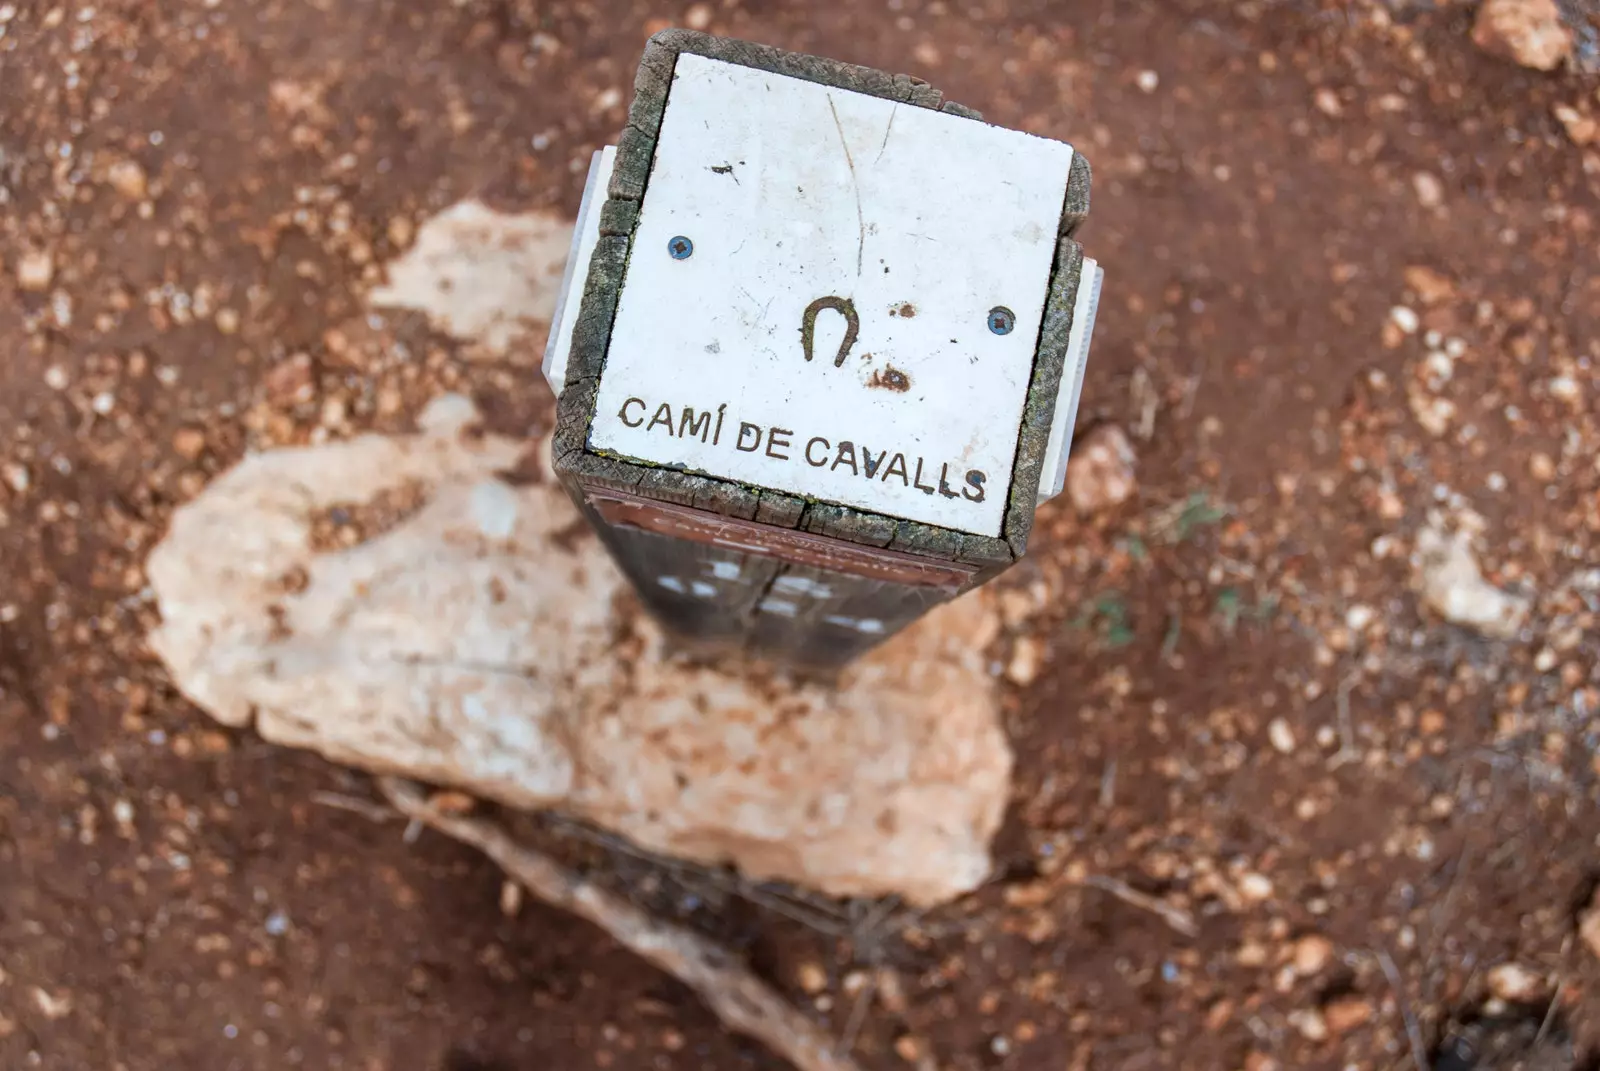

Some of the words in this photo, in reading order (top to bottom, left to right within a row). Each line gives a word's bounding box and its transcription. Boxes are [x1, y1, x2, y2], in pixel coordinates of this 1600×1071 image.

[619, 397, 728, 446] CAMÍ
[736, 421, 794, 460] DE
[805, 437, 986, 503] CAVALLS
